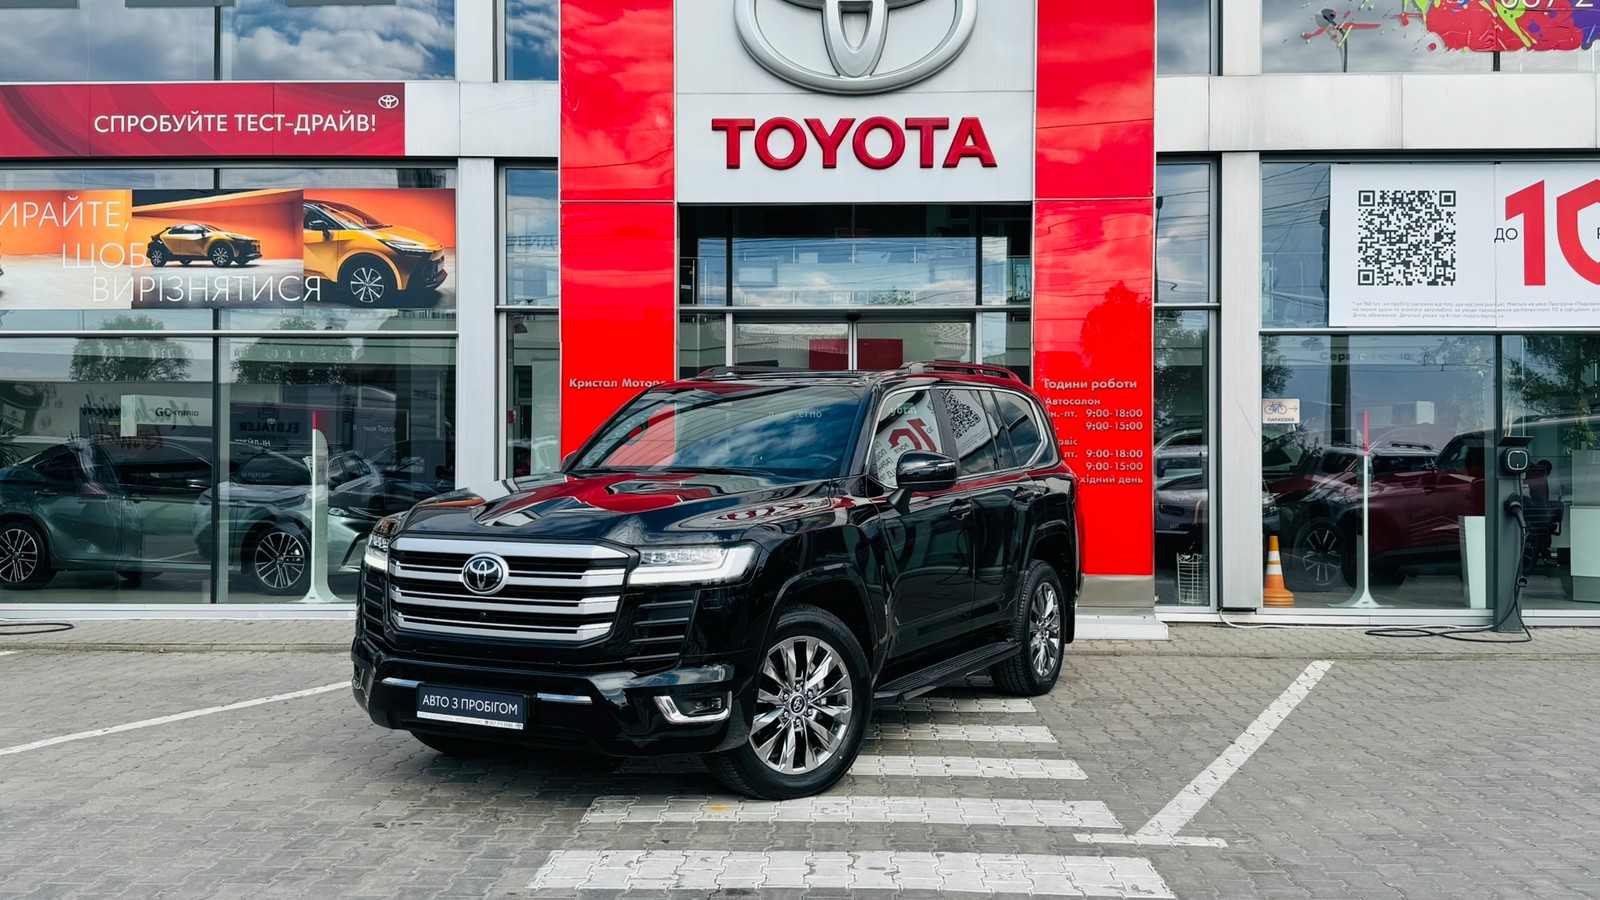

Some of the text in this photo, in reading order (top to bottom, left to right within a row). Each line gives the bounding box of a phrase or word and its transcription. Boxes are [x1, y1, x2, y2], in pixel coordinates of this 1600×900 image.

[94, 109, 377, 135] СПРОБУЙТЕ ТЕСТ-ДРАЙВ!
[711, 116, 998, 170] TOYOTA
[1494, 227, 1519, 243] ДО
[62, 242, 146, 273] ЩОБ
[93, 275, 321, 302] ВИРІЗНЯТИСЯ
[569, 378, 618, 390] Кристал
[1044, 378, 1137, 391] Години роботи
[1045, 397, 1101, 405] Автосалон
[1047, 410, 1078, 418] н.-пт.
[1058, 436, 1078, 446] рвіс
[1077, 474, 1116, 484] хідний
[422, 694, 450, 708] АВТО
[461, 698, 518, 715] ПРОБІГОМ
